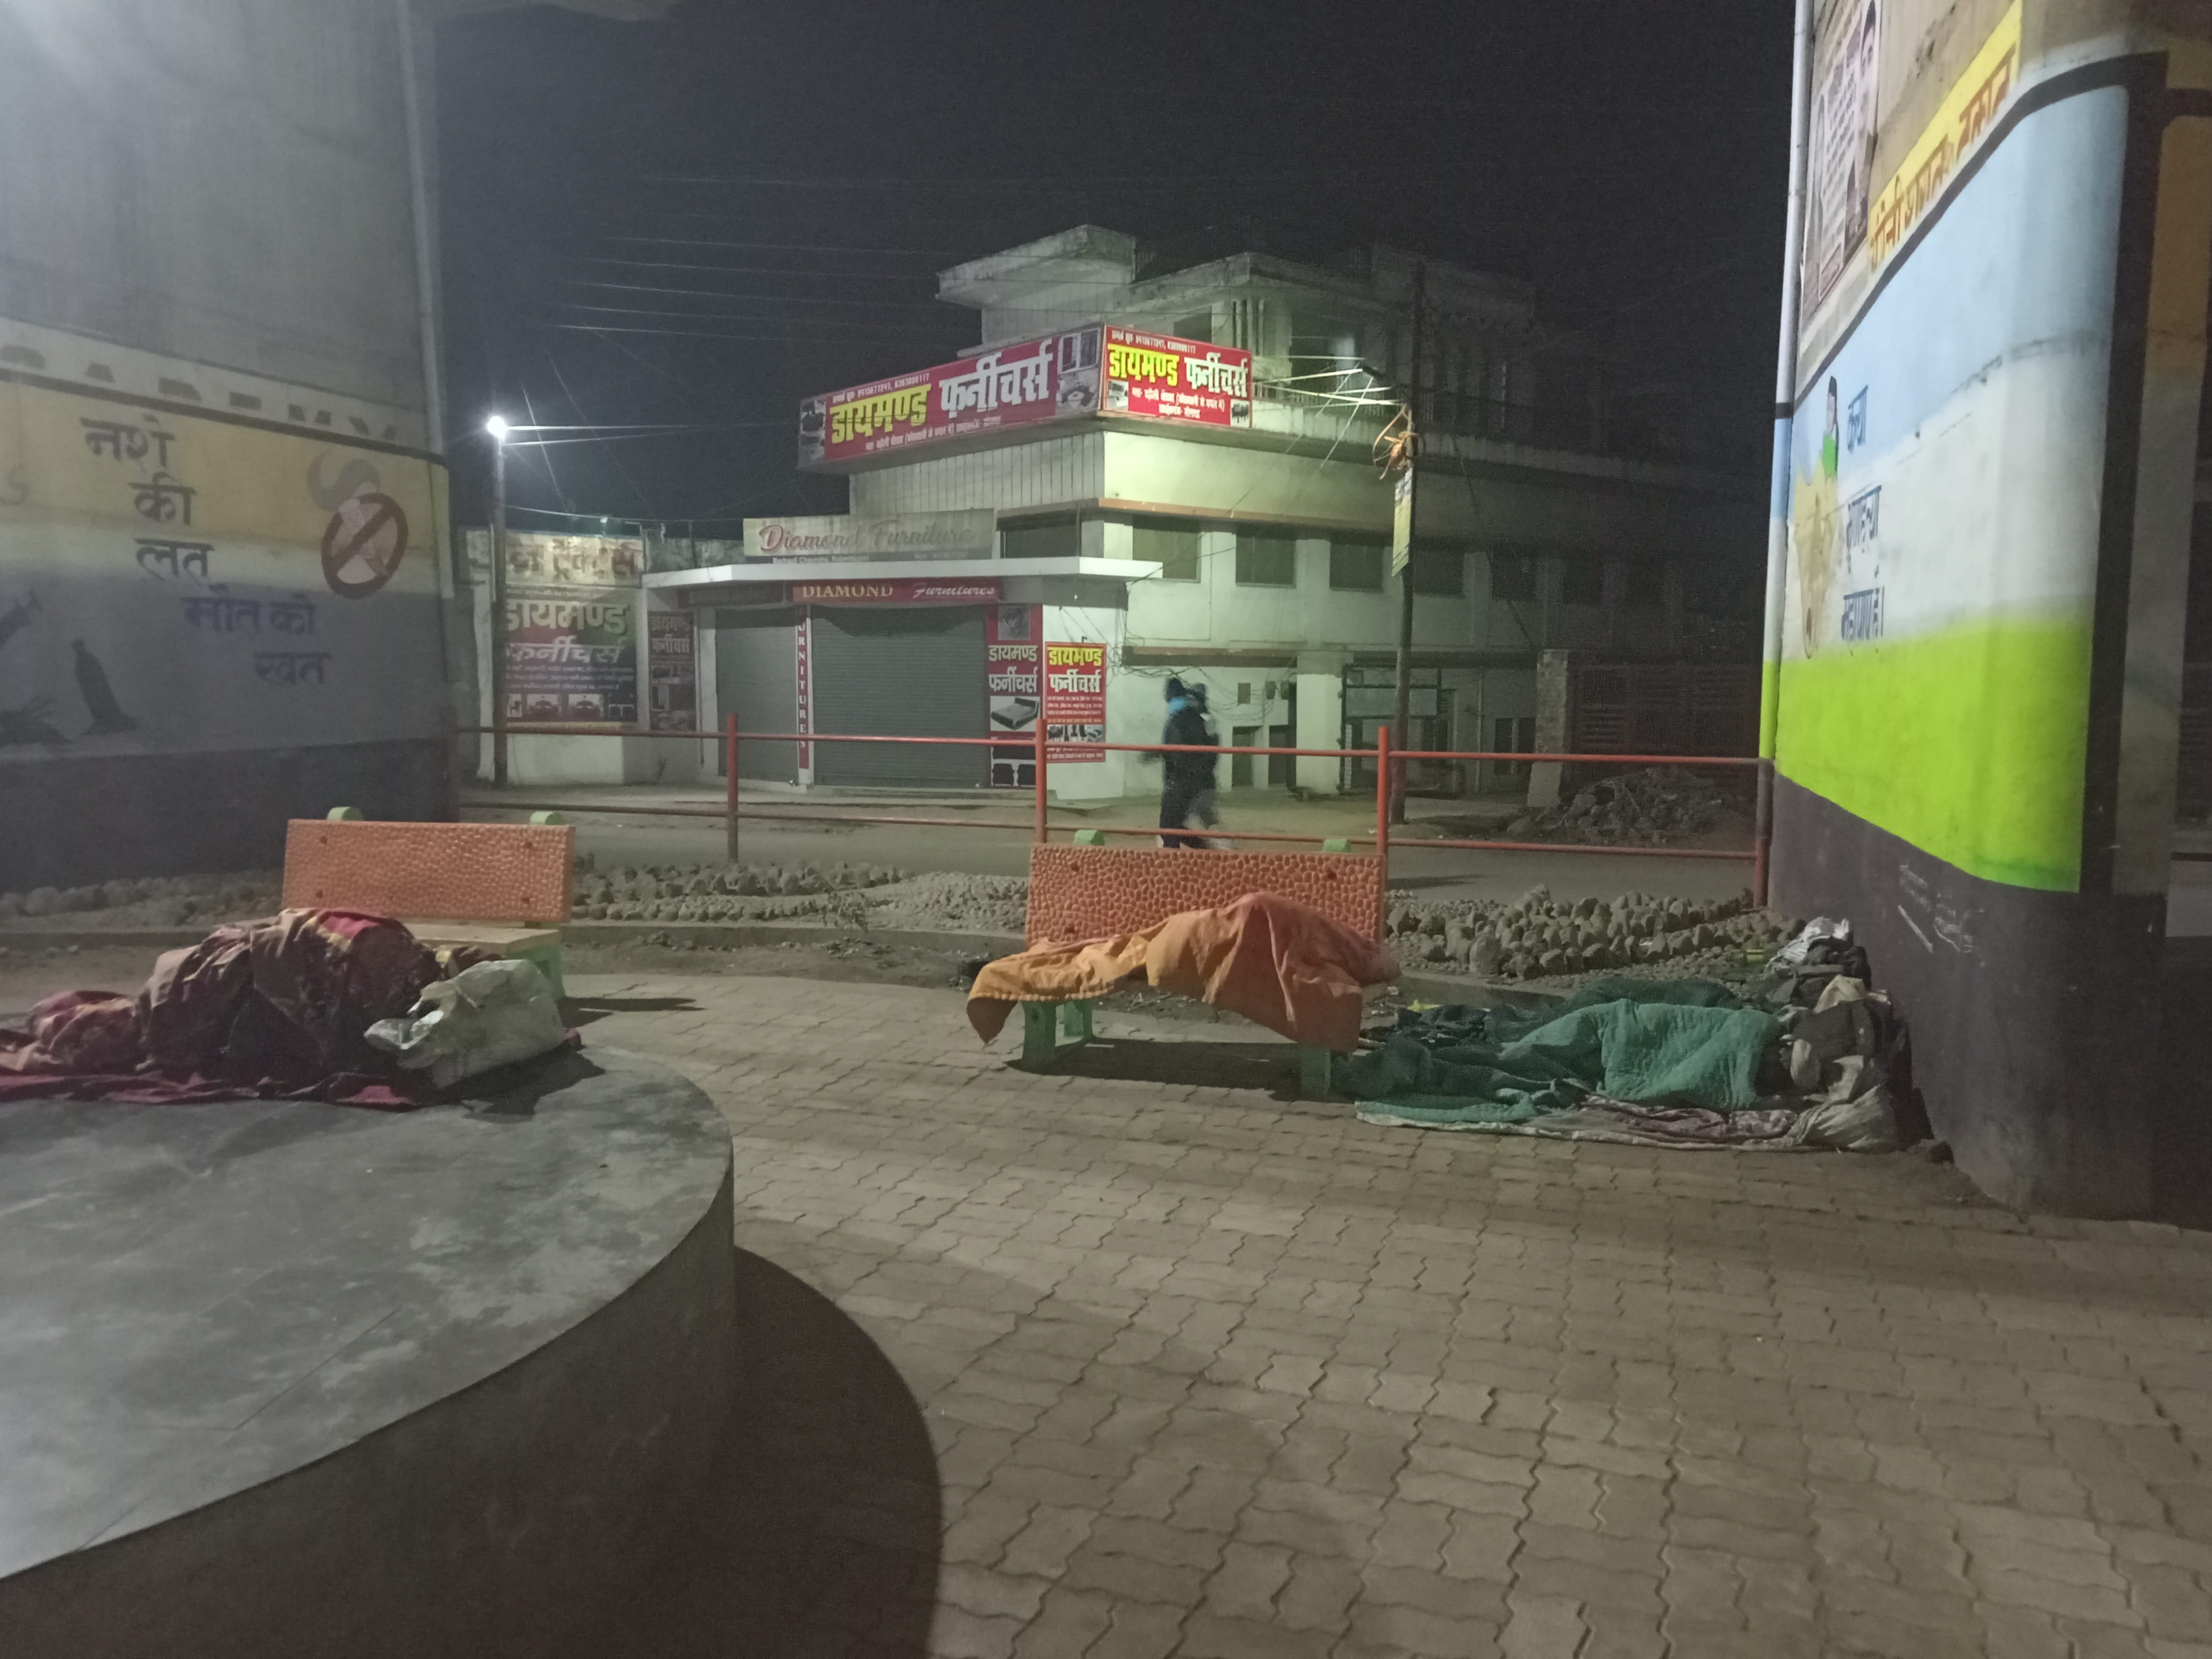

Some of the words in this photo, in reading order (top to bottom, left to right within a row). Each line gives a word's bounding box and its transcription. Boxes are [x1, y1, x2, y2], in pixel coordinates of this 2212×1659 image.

[1108, 342, 1179, 387] डायमण्ड
[1184, 353, 1247, 398] फर्नीचर्स
[830, 383, 931, 444] डायमण्ड
[939, 340, 1053, 418] फर्नीचर्स
[80, 414, 174, 473] नशे
[128, 471, 197, 526] की
[758, 524, 860, 554] Diamond
[135, 539, 214, 585] लत
[802, 584, 893, 598] DIAMOND
[913, 582, 994, 599] Furnitures
[988, 645, 1038, 661] डायमण्ड
[1048, 647, 1103, 666] डायमण्ड
[798, 621, 807, 749] URNITURES
[988, 666, 1038, 693] फर्नीचर्स
[1049, 669, 1101, 693] फर्नीचर्स
